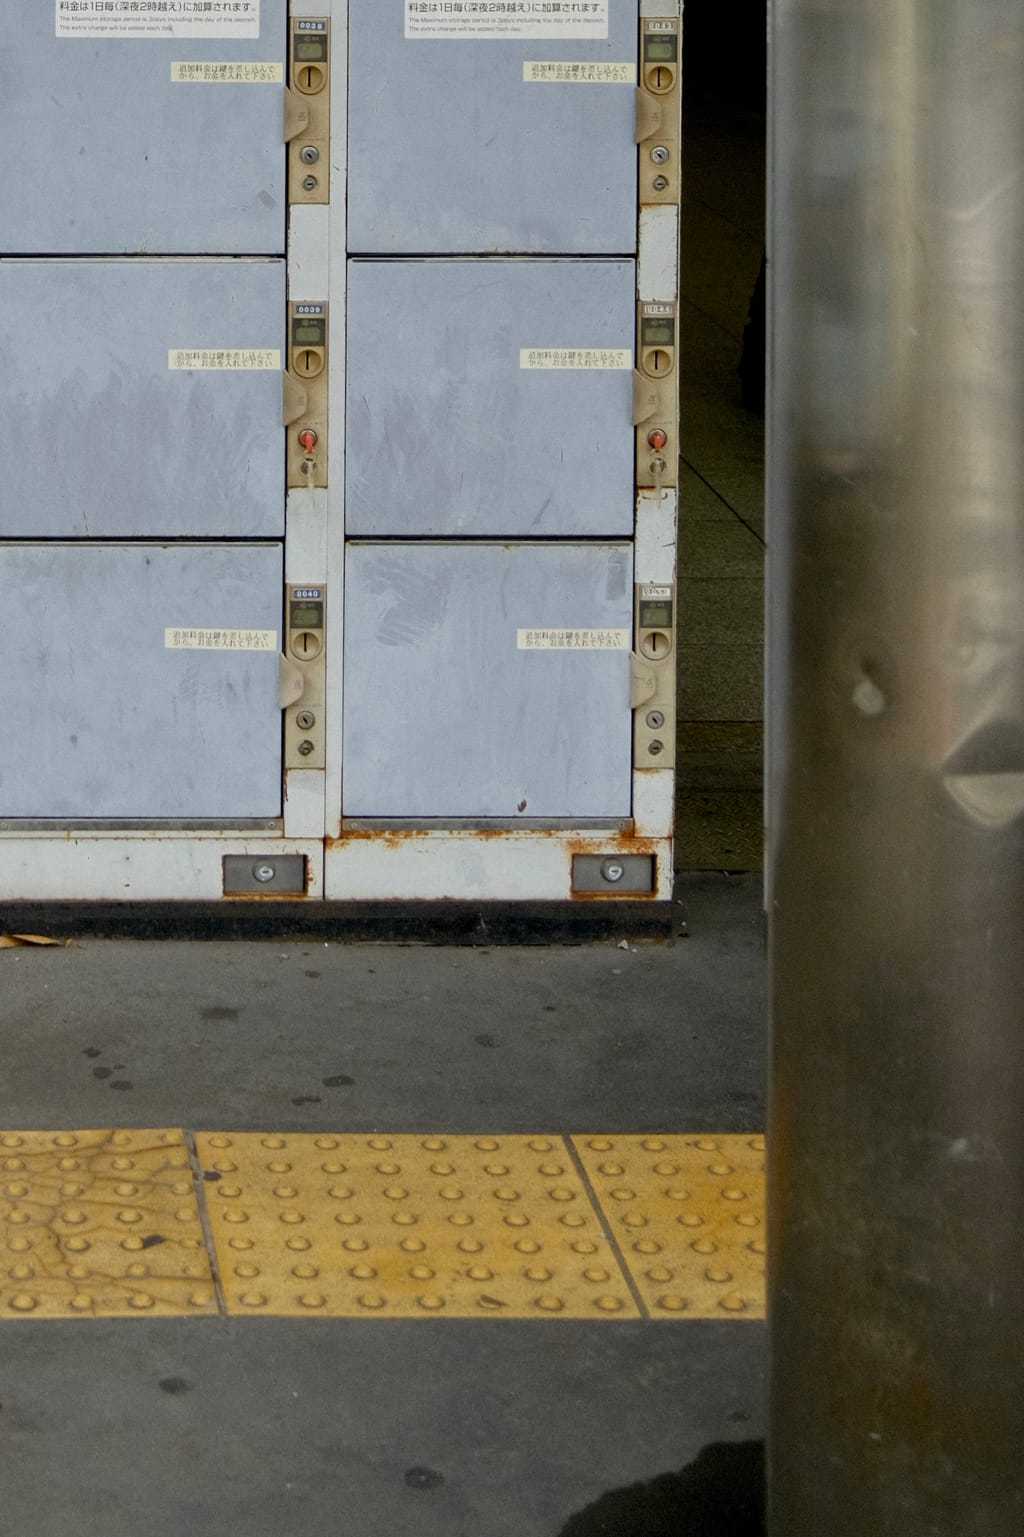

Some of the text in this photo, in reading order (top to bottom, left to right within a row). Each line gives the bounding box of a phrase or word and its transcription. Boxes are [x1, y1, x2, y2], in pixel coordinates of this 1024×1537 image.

[60, 1, 256, 12] 料金は1日毎(深夜2時越え)に加算されます。
[408, 2, 604, 13] 料金は1日毎(深夜2時越え)に加算されます。
